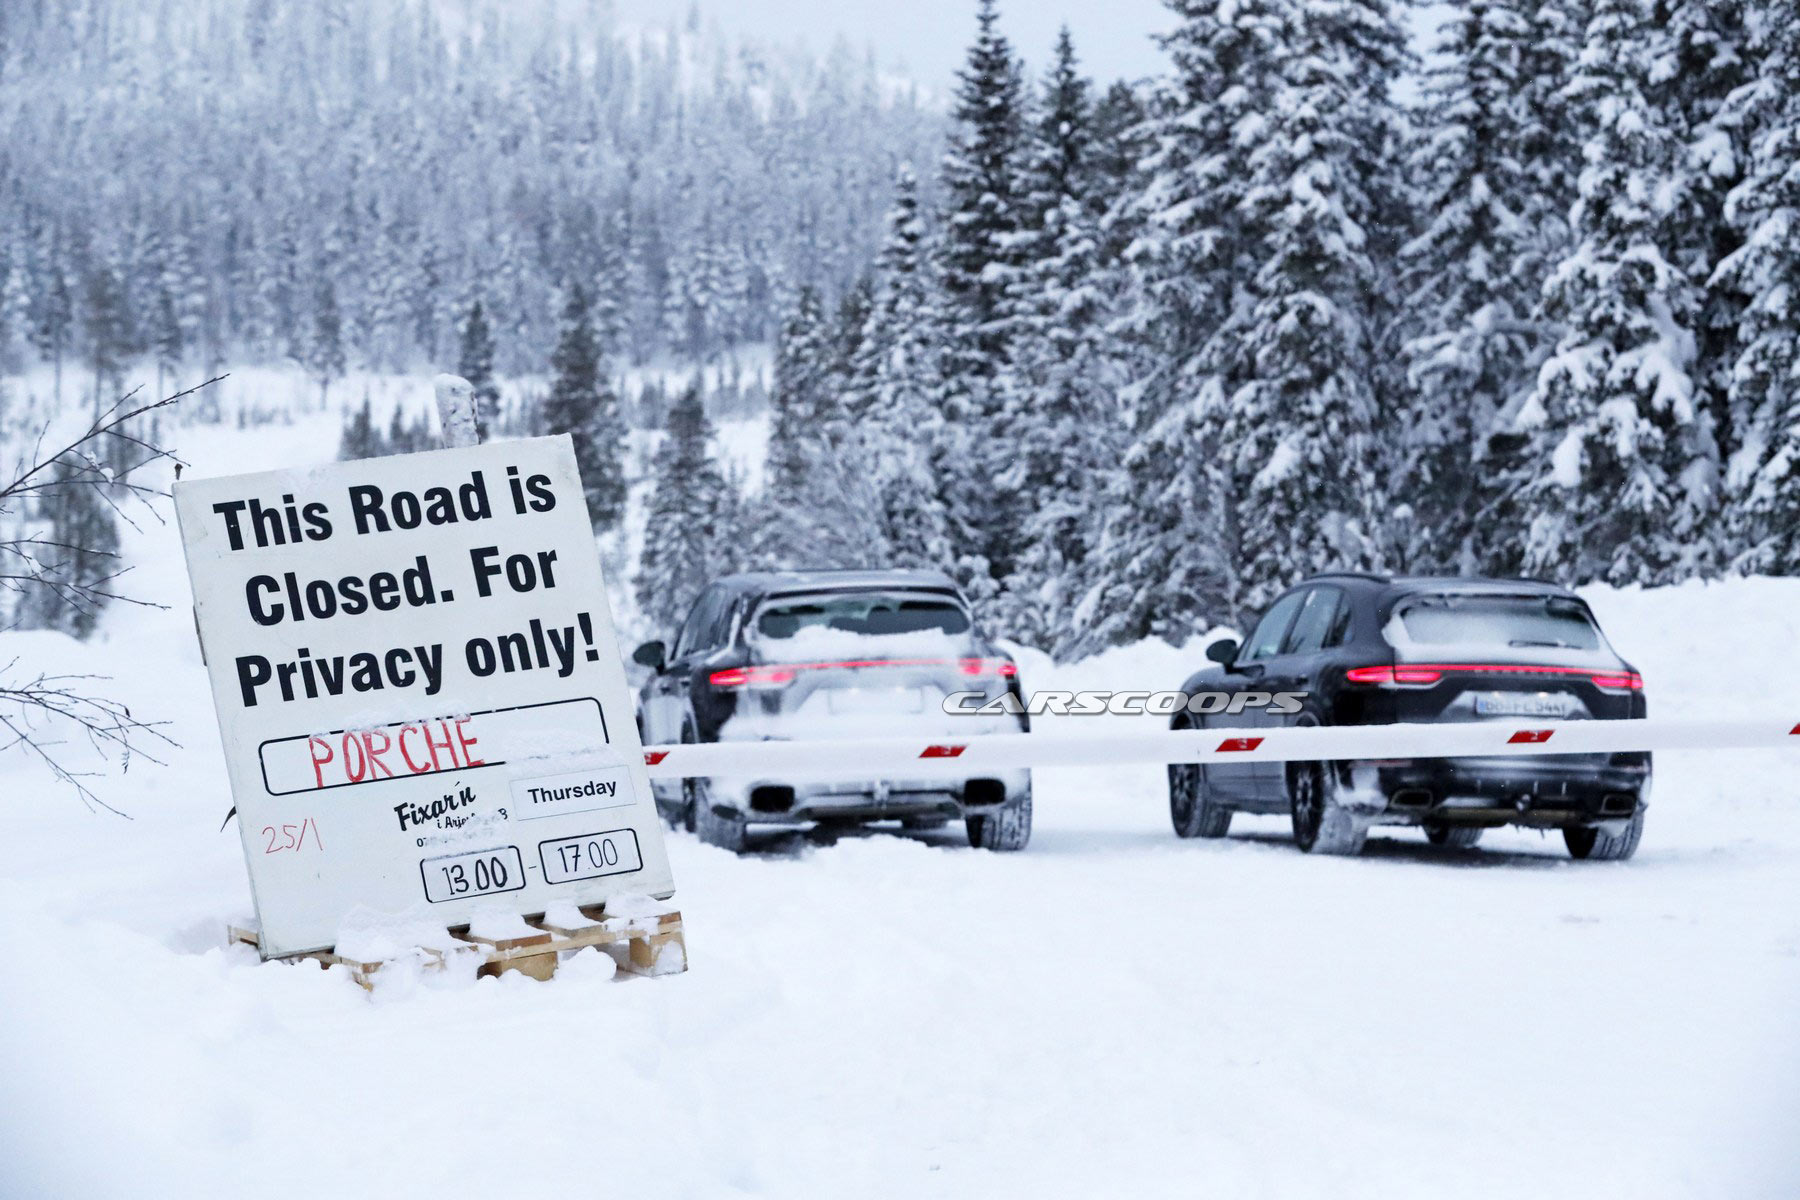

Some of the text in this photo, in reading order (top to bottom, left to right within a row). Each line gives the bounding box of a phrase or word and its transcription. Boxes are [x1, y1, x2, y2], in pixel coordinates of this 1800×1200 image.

[213, 466, 556, 550] This Road is
[245, 546, 558, 626] Closed. For
[236, 612, 600, 707] Privacy only!
[308, 716, 485, 789] PORCHE
[528, 779, 618, 804] Thursday
[442, 856, 509, 896] 13.00
[557, 838, 618, 874] 17.00
